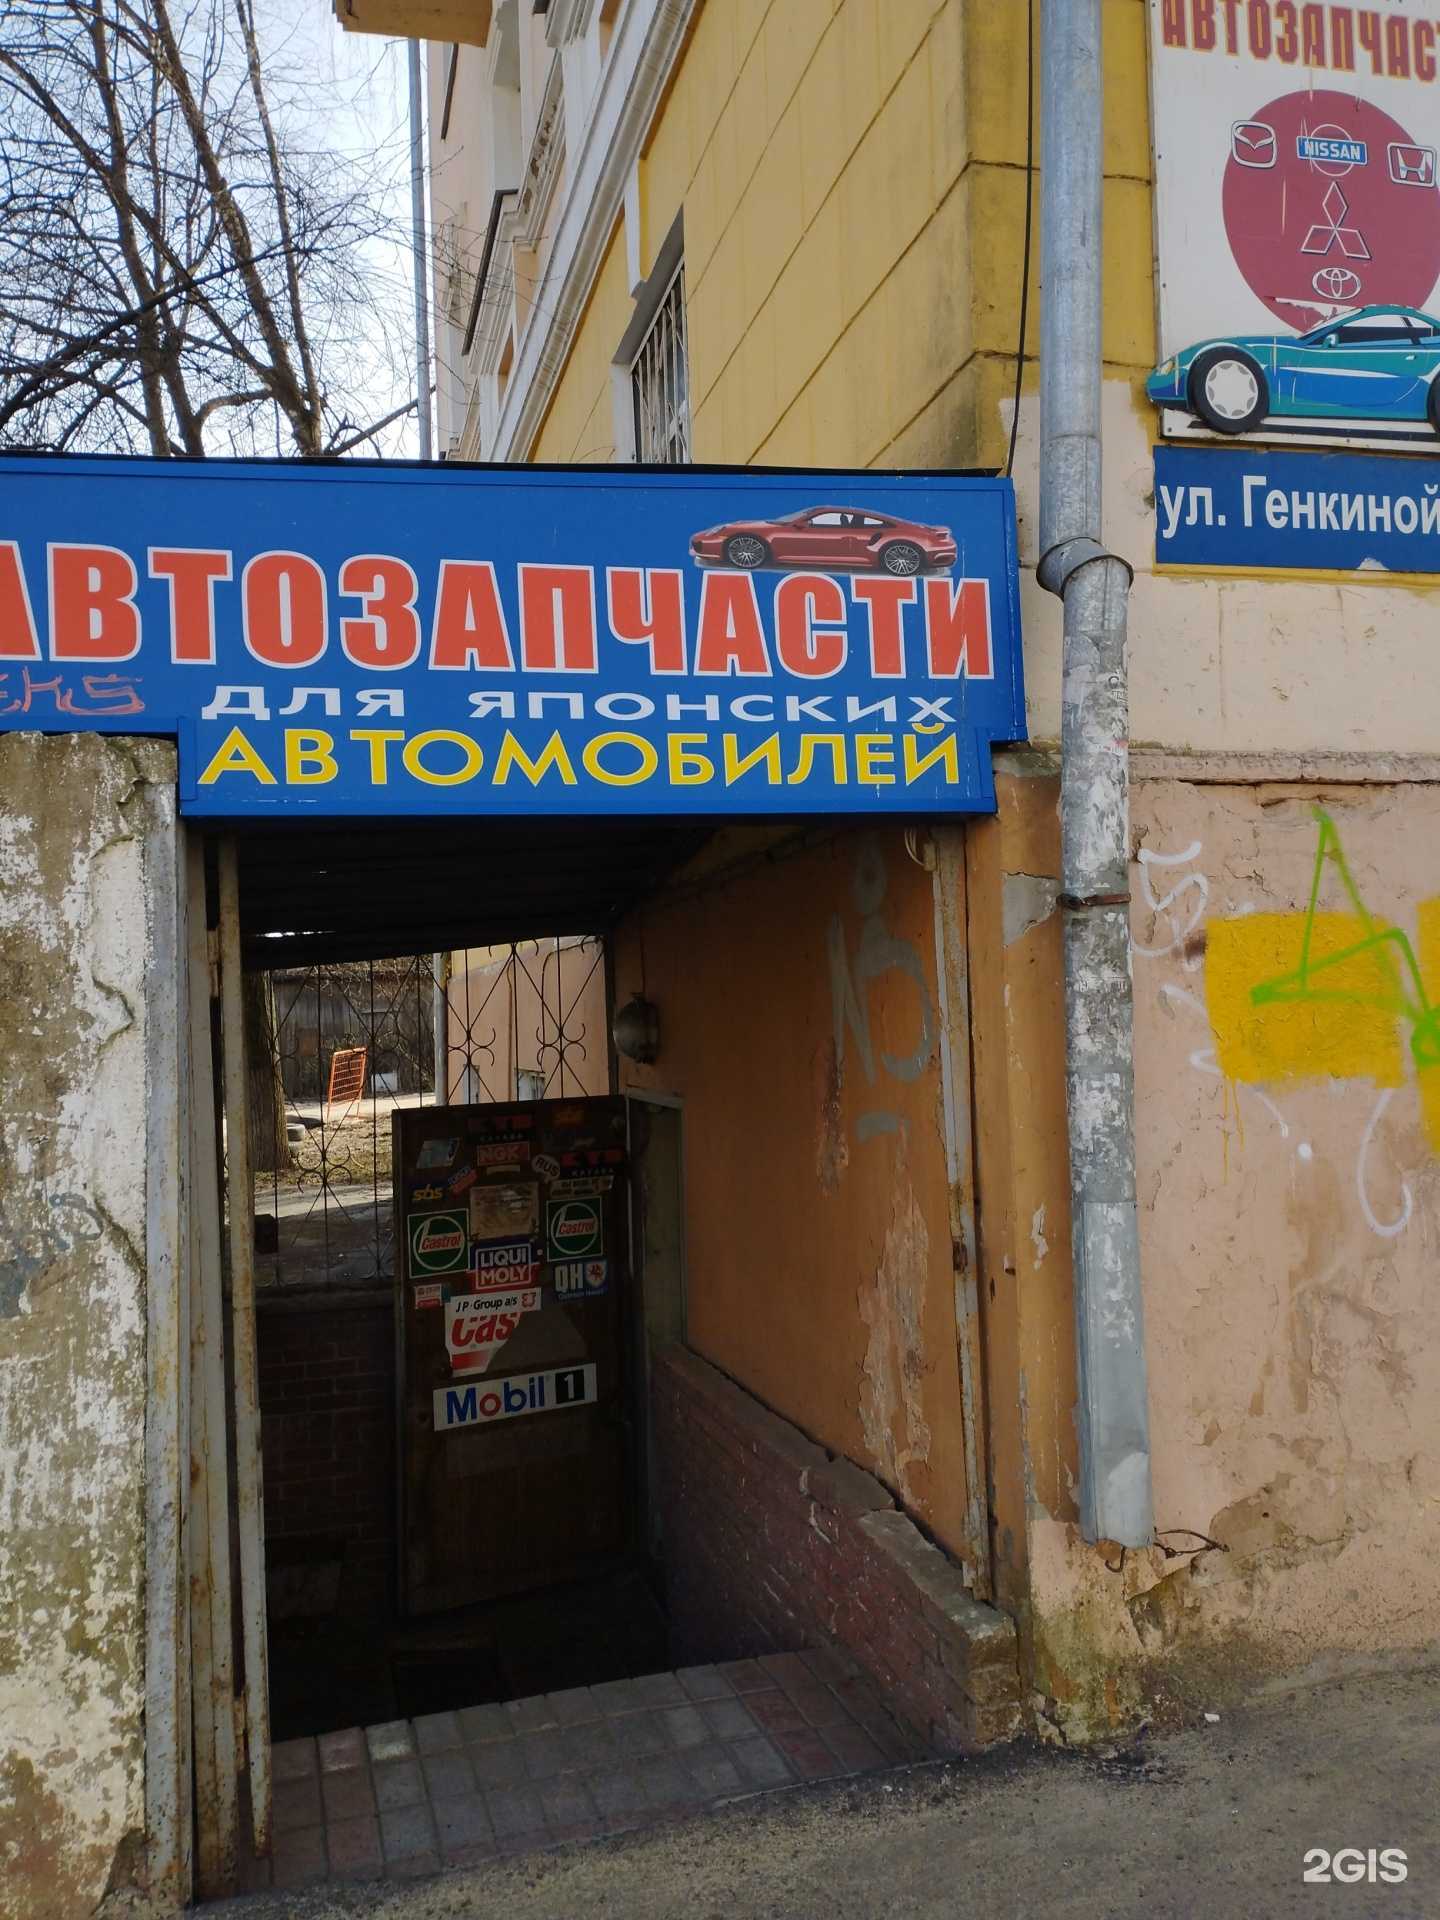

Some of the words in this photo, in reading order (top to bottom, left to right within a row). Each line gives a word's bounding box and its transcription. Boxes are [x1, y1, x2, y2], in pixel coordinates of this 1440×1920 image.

[1161, 0, 1440, 83] АВТОЗАПЧАС
[1304, 140, 1361, 161] NISSAN
[1159, 484, 1227, 539] ул.
[1242, 474, 1440, 535] Генкиной
[197, 722, 960, 788] АВТОМОБИЛЕЙ
[480, 1247, 527, 1267] LIQUI
[481, 1264, 530, 1286] MOLY
[473, 1298, 503, 1311] Group
[446, 1376, 545, 1425] Mobil
[563, 1373, 575, 1400] 1
